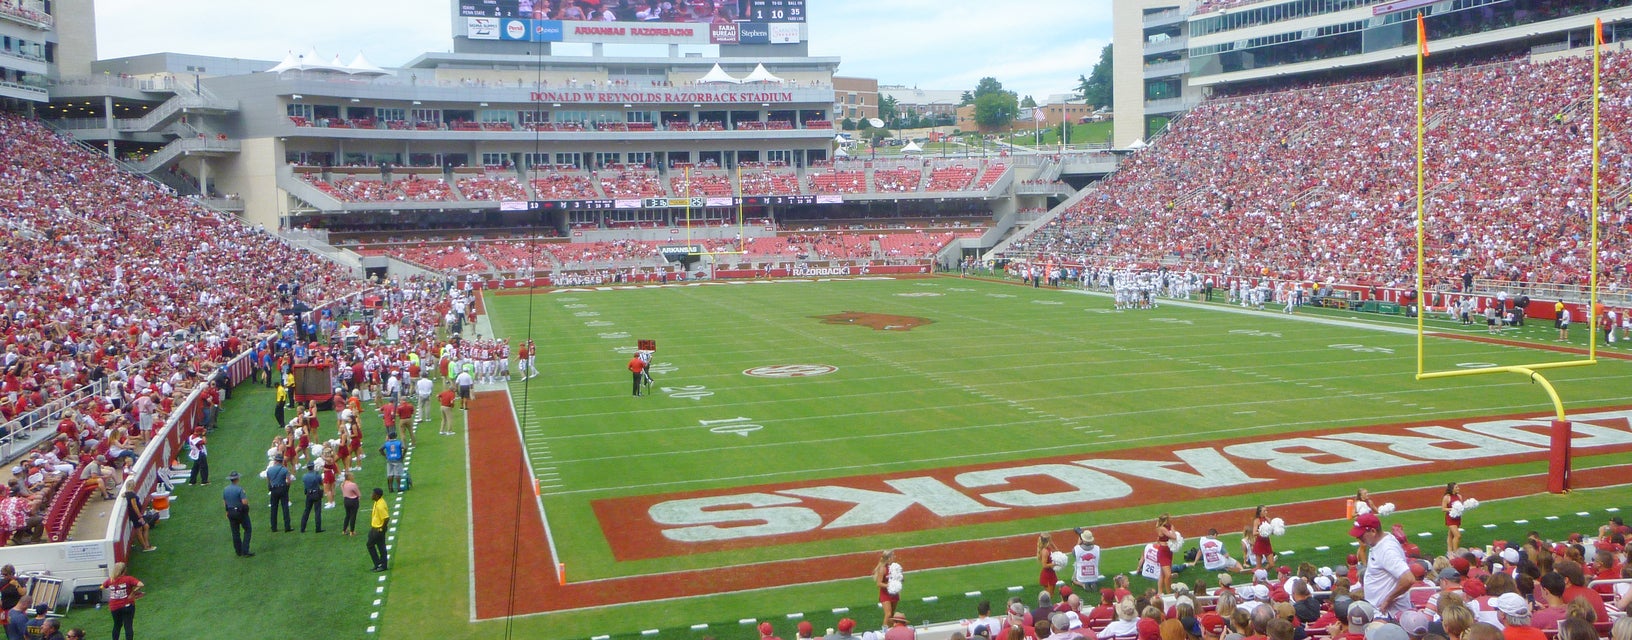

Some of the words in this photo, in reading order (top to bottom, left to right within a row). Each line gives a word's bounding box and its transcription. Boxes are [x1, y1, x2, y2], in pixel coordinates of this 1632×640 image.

[757, 10, 763, 19] 1
[771, 10, 784, 19] 10
[790, 8, 800, 16] 35
[575, 26, 626, 36] ARKANSAS
[630, 27, 694, 37] RAZORBACKS
[741, 29, 768, 38] Stephens
[530, 92, 581, 102] DONALD
[584, 92, 595, 102] W
[597, 92, 662, 102] REYNOLDS
[664, 92, 737, 103] RAZORBACK
[740, 92, 793, 102] STADIUM
[698, 416, 764, 437] 10
[1146, 564, 1154, 573] 26
